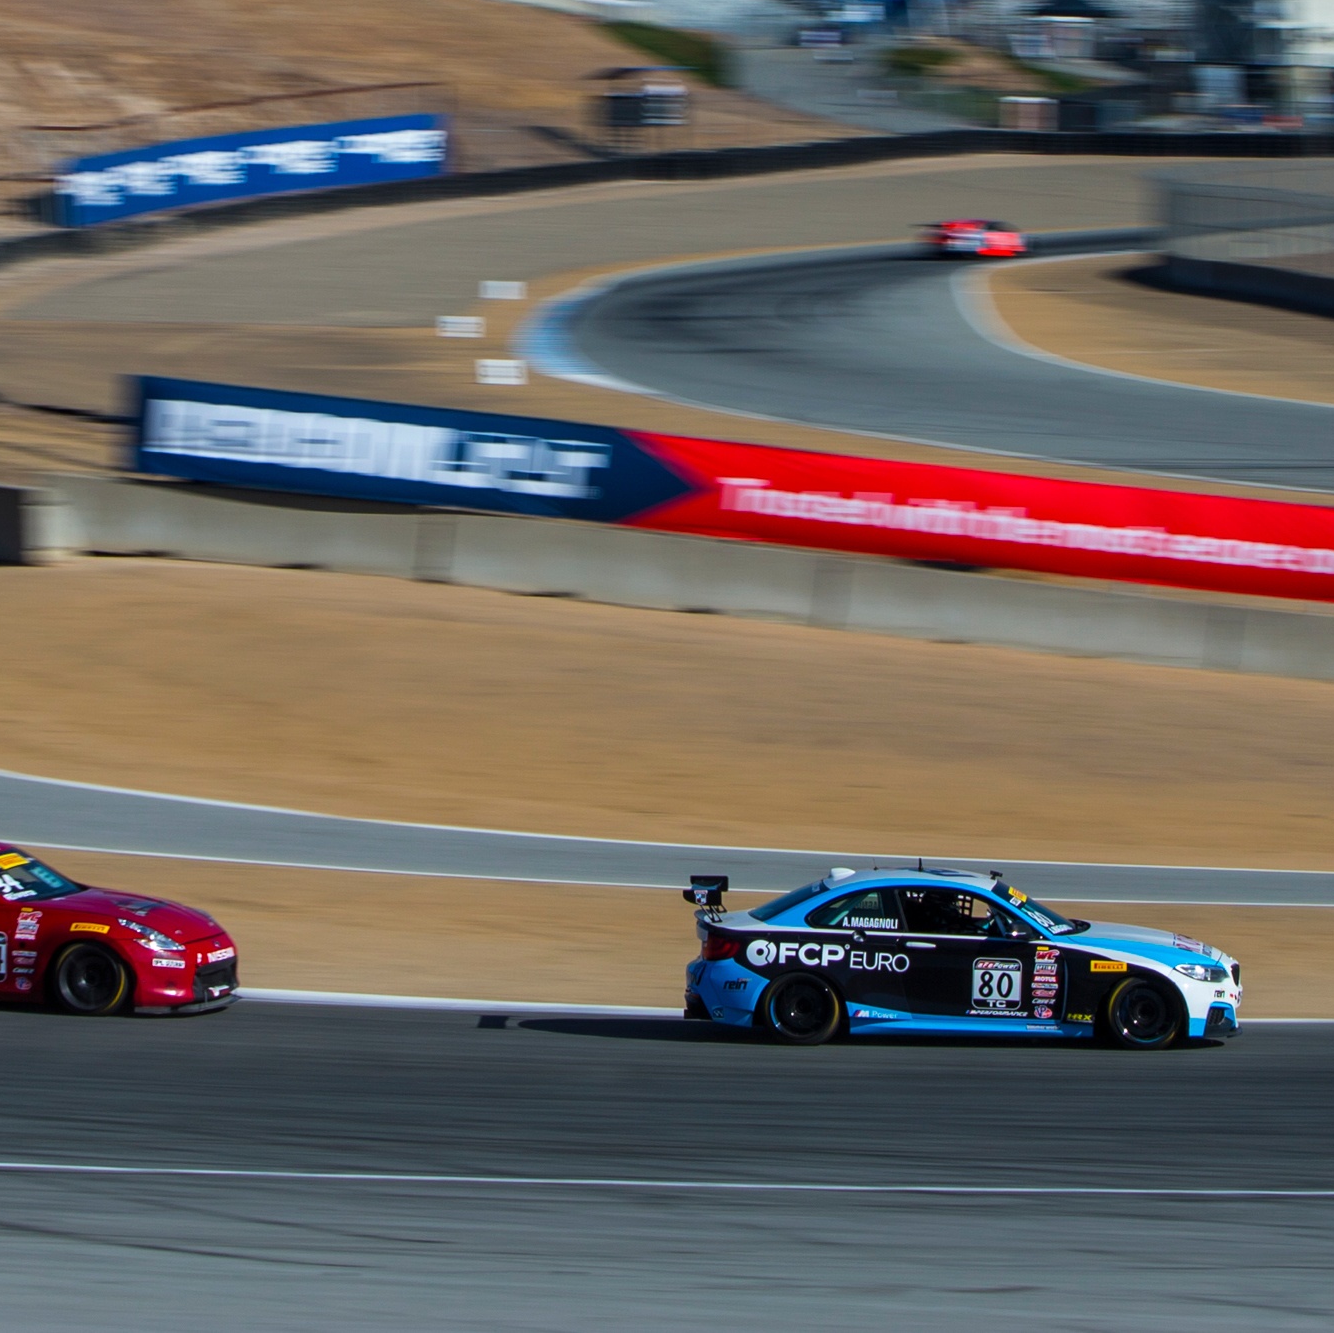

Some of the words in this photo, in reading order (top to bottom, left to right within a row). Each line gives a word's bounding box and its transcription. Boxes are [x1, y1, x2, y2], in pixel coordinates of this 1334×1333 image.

[779, 943, 845, 966] FCP
[850, 951, 910, 972] EURO
[979, 971, 1013, 998] 80
[987, 1000, 1006, 1008] TC
